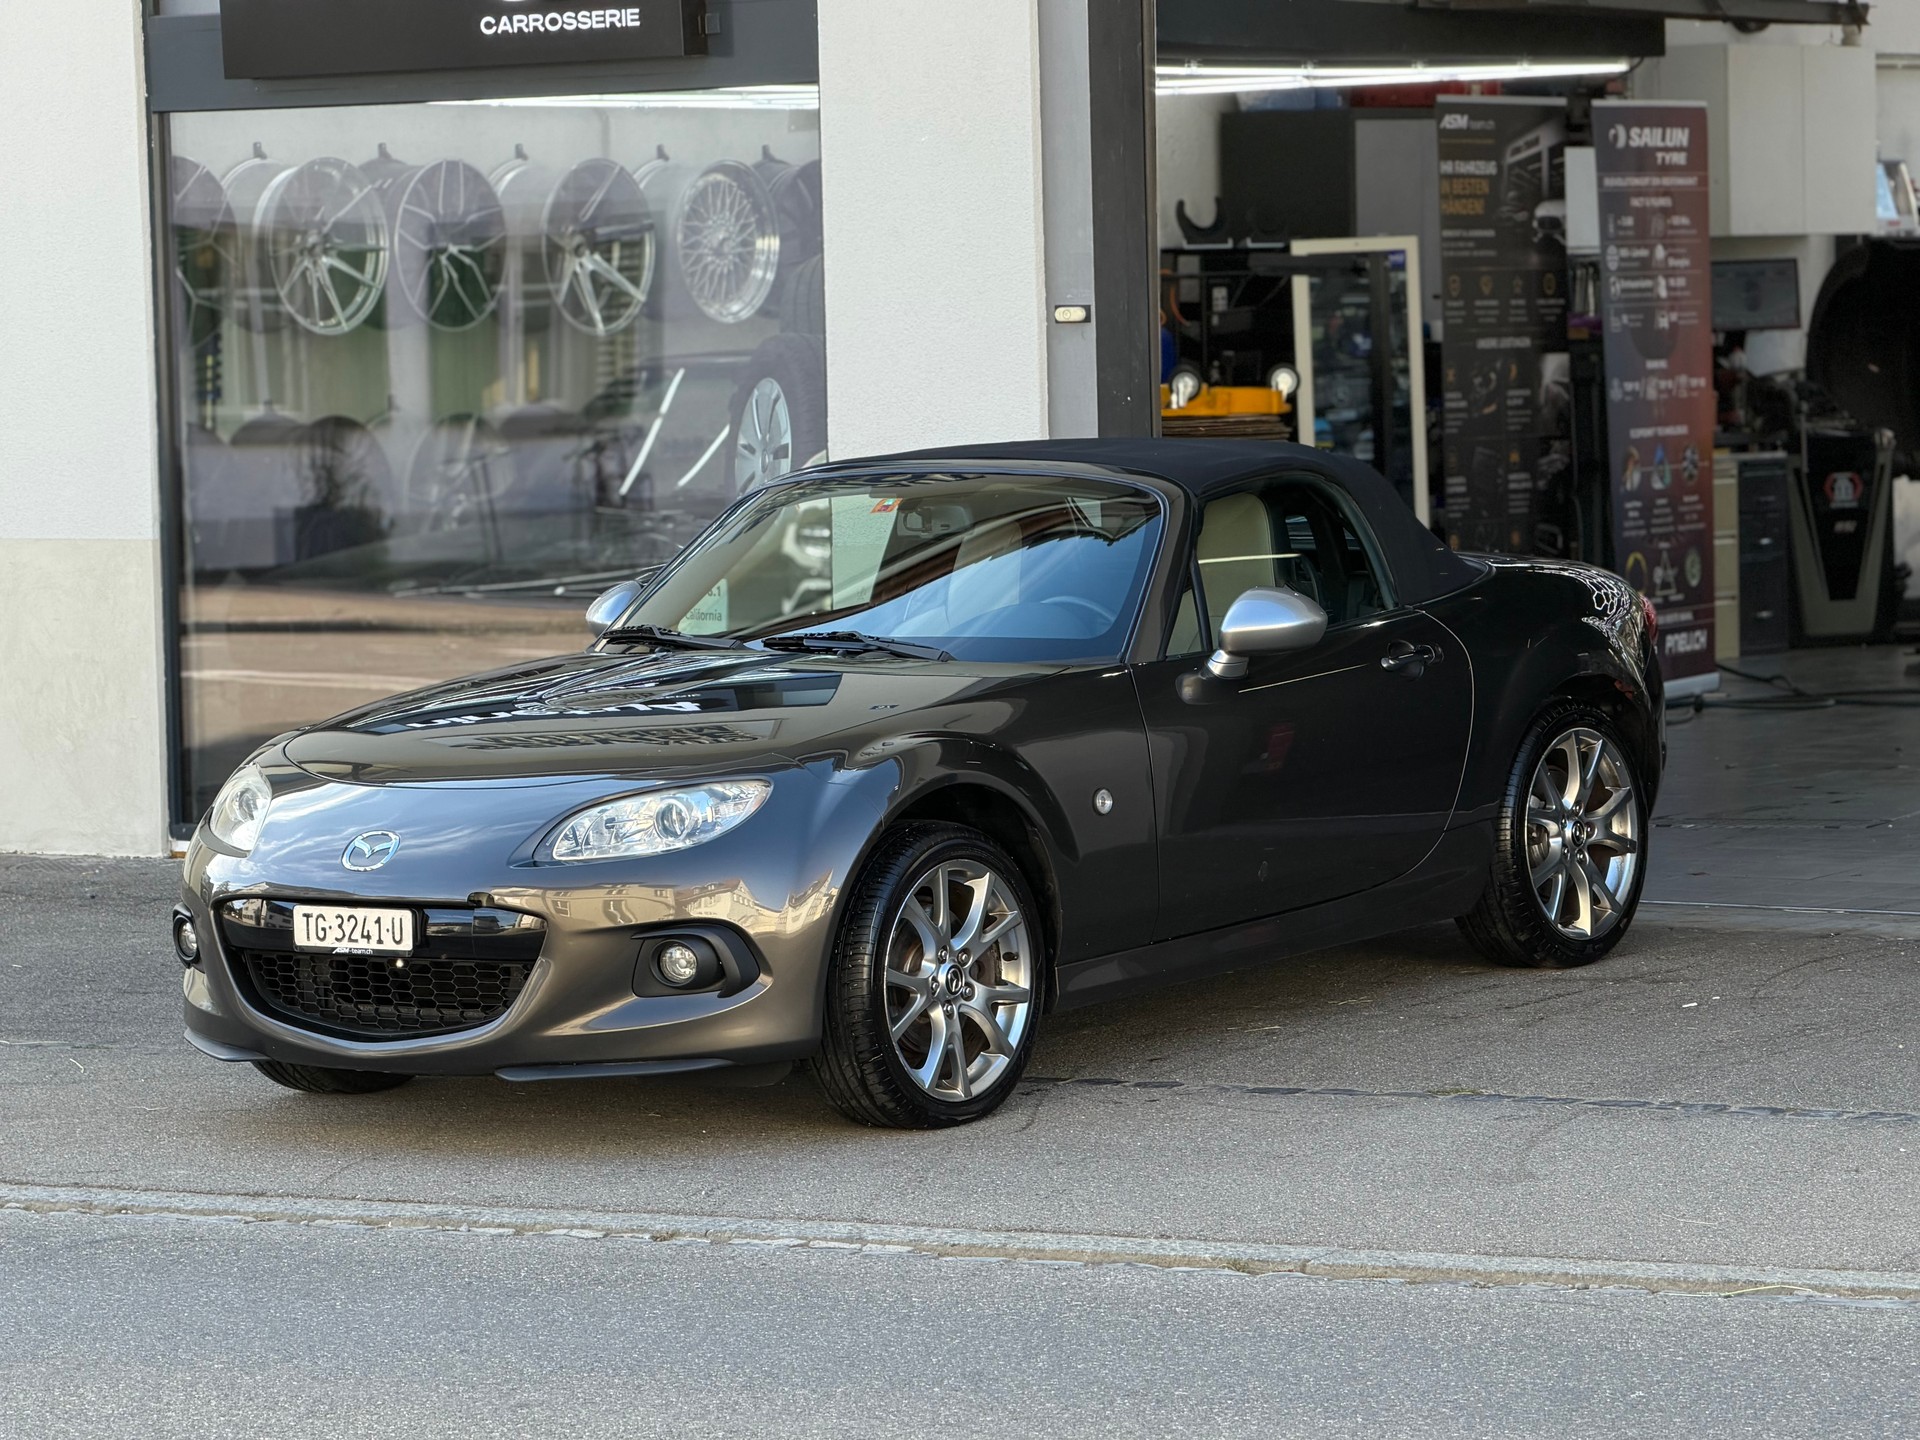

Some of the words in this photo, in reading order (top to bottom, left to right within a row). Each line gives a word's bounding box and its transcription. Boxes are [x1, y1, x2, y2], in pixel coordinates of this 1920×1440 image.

[480, 8, 641, 35] CARROSSERIE
[1628, 127, 1690, 148] SAILUN
[1655, 151, 1688, 166] TYRE
